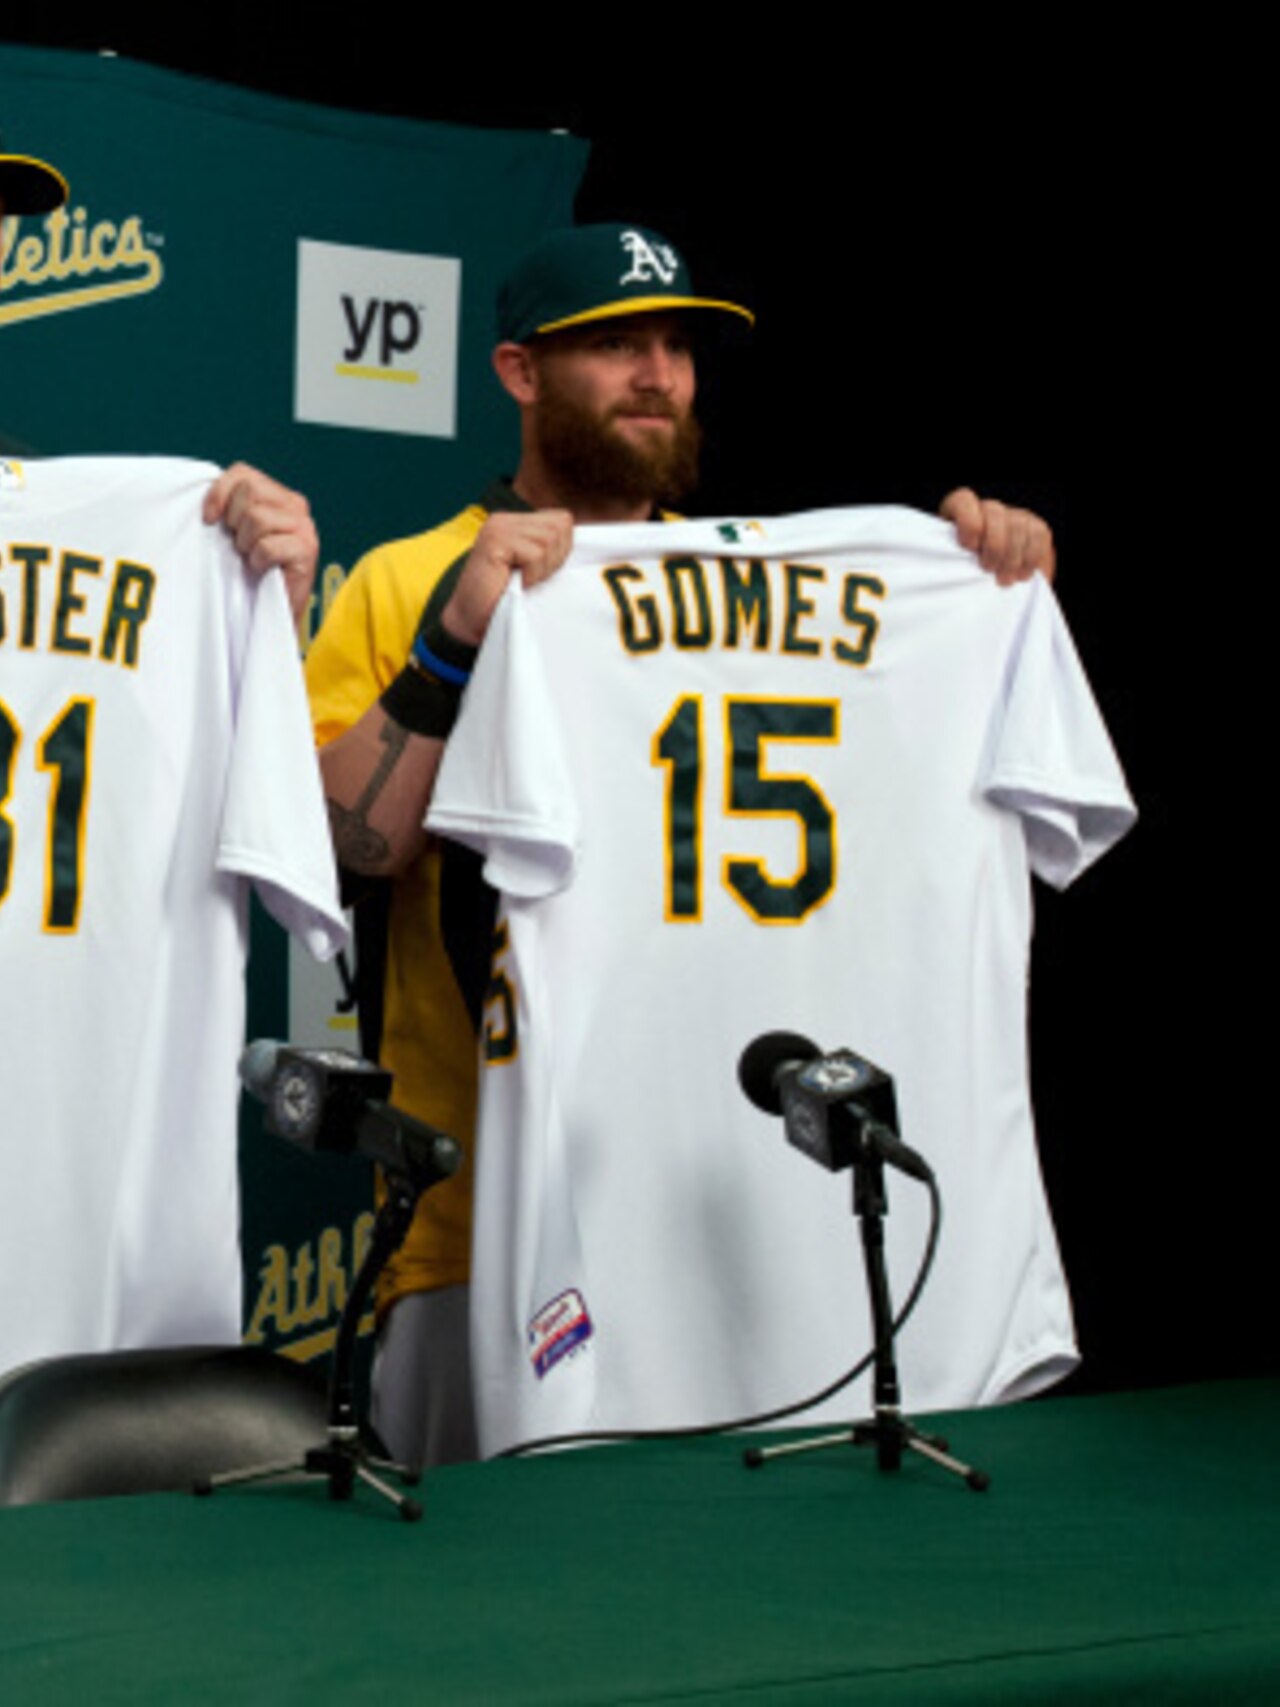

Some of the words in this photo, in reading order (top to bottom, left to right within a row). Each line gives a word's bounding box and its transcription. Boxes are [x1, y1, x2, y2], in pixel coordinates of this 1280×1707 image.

[340, 294, 420, 366] yp
[602, 555, 886, 669] GOMES
[651, 694, 841, 926] 15
